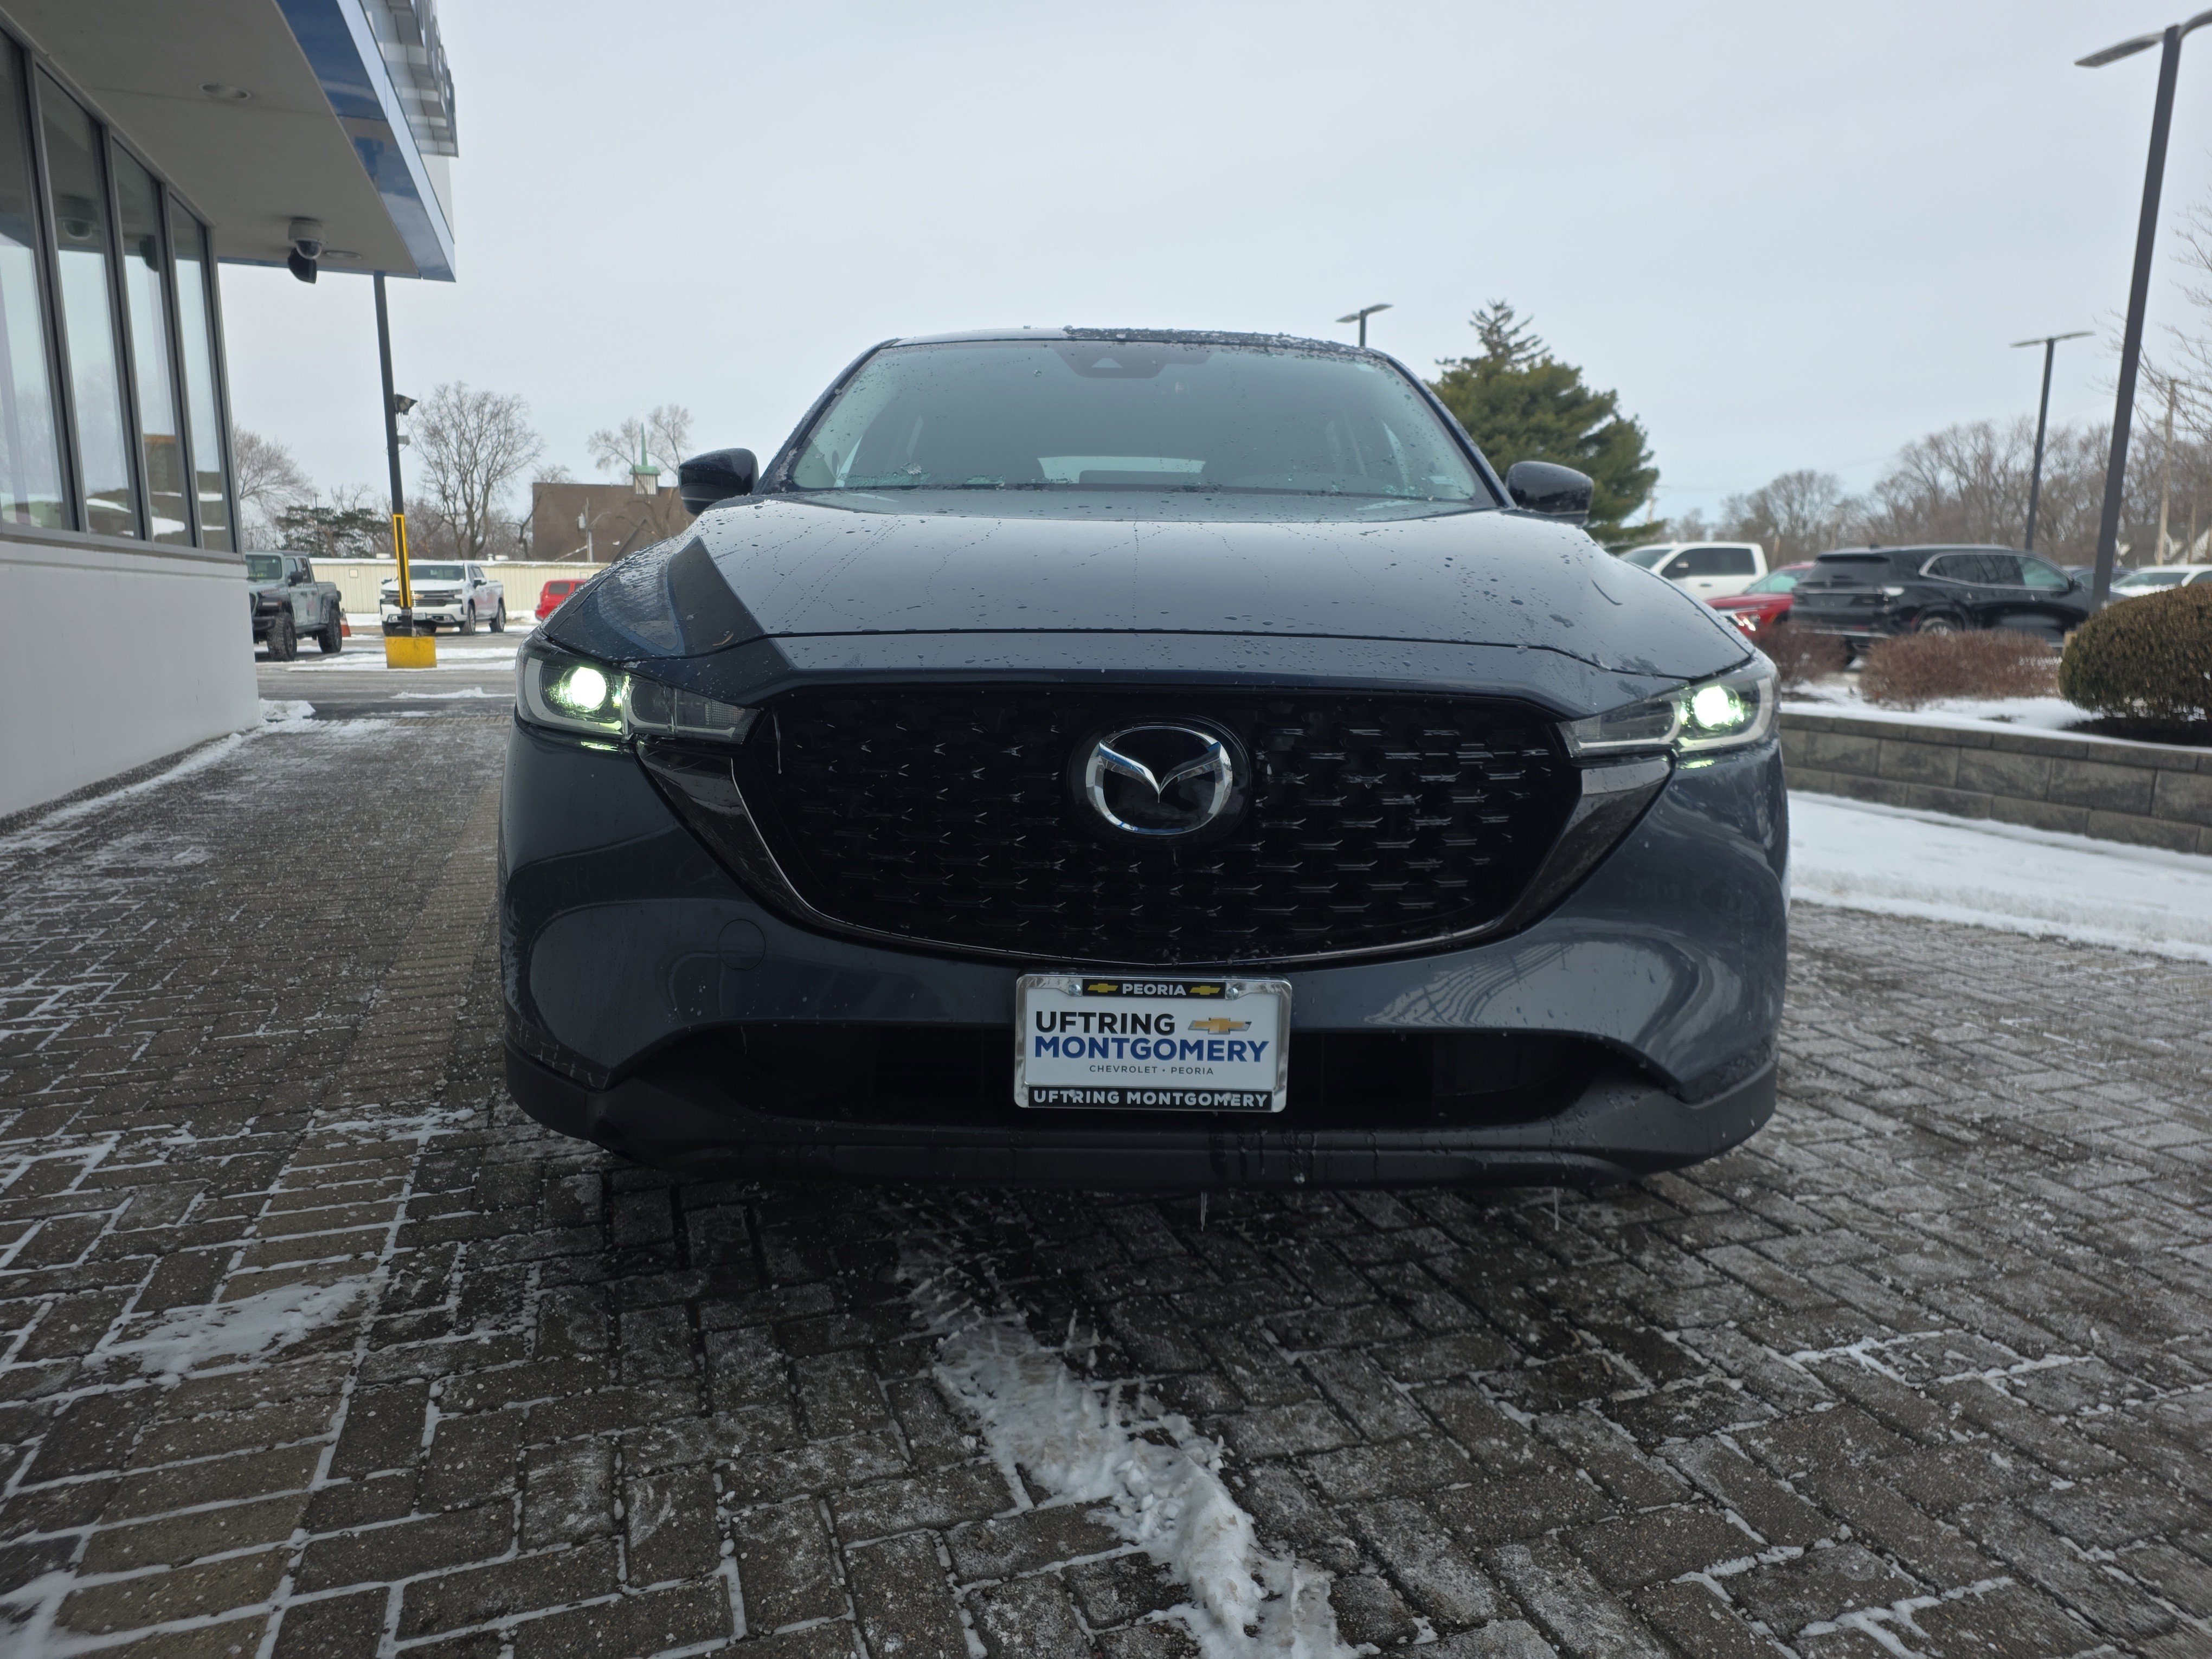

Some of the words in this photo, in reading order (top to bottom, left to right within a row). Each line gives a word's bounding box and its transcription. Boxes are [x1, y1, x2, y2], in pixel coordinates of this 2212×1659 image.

[1122, 983, 1186, 995] PEORIA
[1036, 1011, 1175, 1036] UFTRING
[1034, 1036, 1269, 1063] MONTGOMERY
[1089, 1065, 1158, 1073] CHEVROLET
[1171, 1066, 1214, 1075] PEORIA
[1033, 1090, 1120, 1104] UFTRING
[1127, 1091, 1268, 1107] MONTGOMERY
